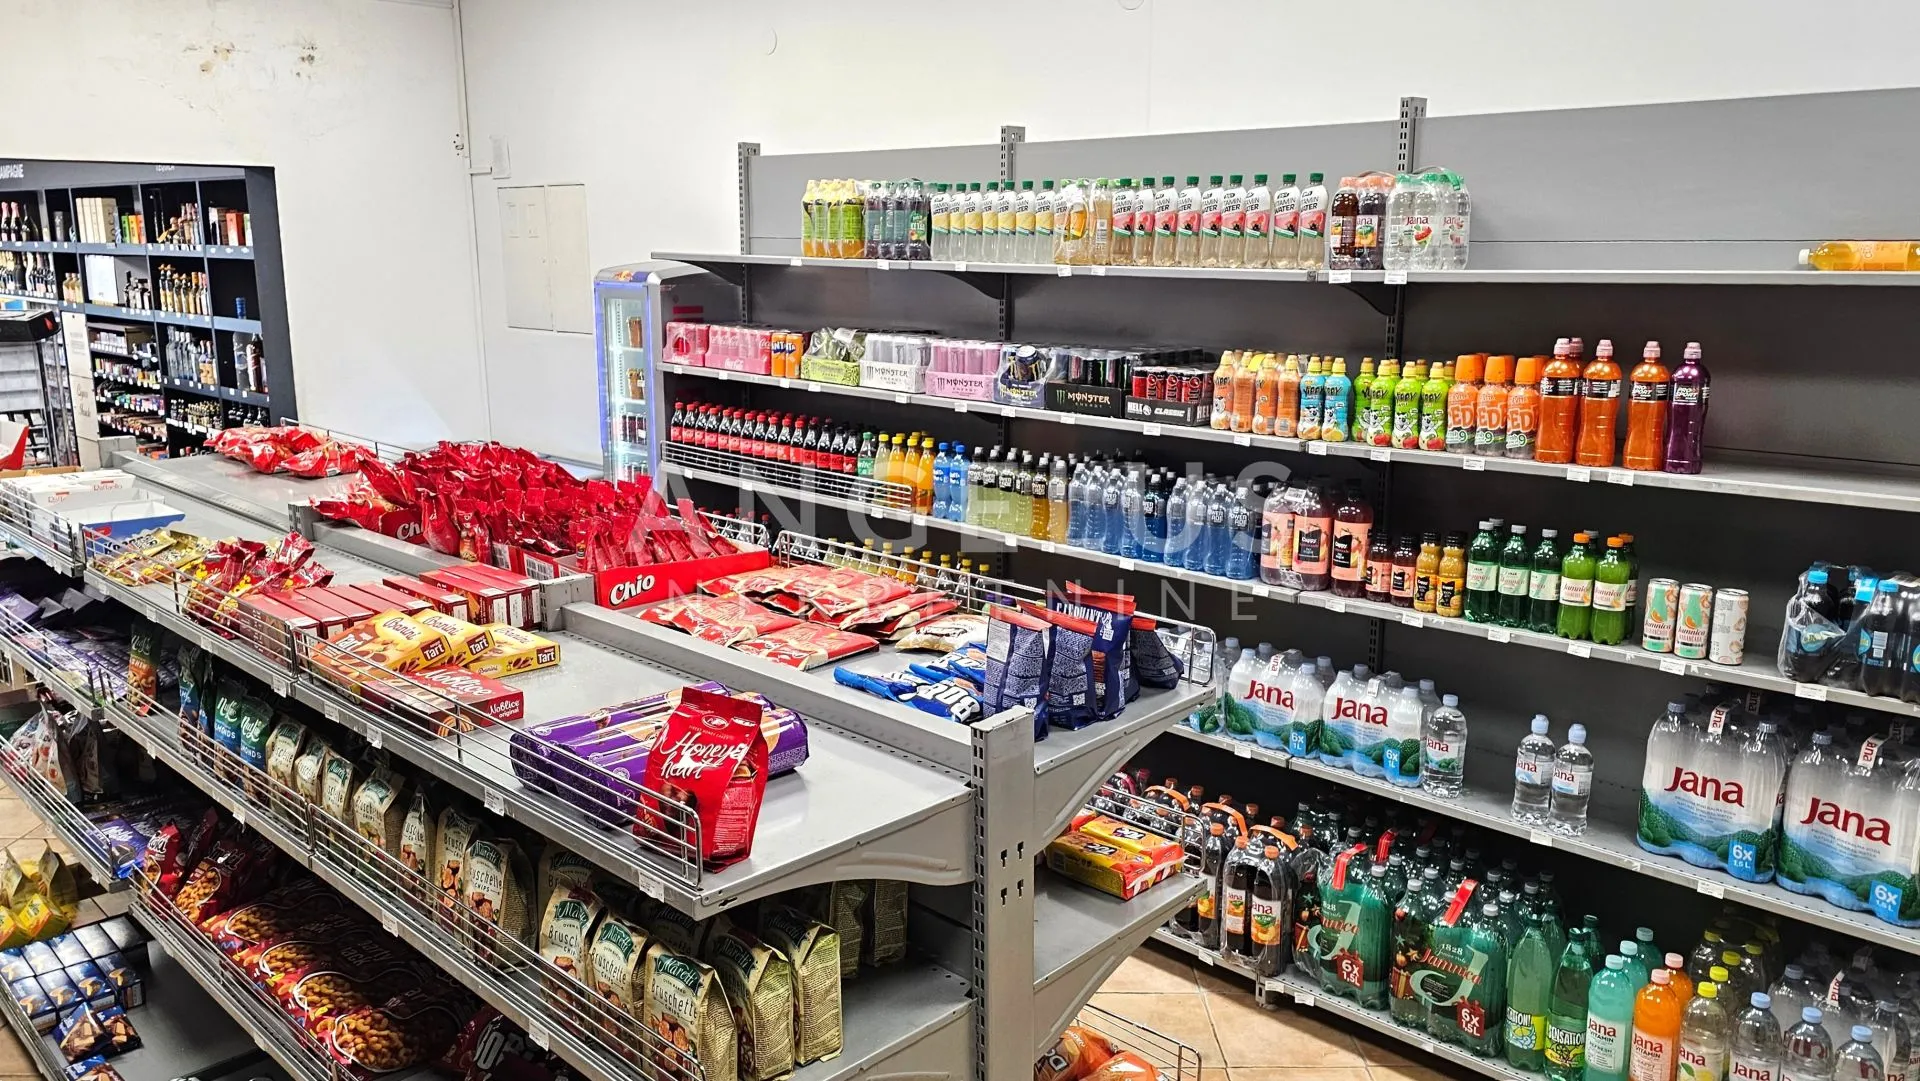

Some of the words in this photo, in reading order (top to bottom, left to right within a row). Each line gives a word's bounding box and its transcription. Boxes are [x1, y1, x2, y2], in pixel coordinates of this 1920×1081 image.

[874, 367, 908, 377] MONSTER
[946, 379, 984, 389] MONSTER
[1067, 391, 1111, 405] MONSTER
[1154, 407, 1186, 417] CLASSIC
[1196, 405, 1210, 420] HEL
[609, 574, 656, 606] Chio
[424, 643, 445, 660] Tart
[469, 637, 489, 655] Tart
[537, 650, 556, 664] Tart
[1244, 679, 1295, 711] Jana
[1332, 696, 1389, 728] Jana
[1291, 731, 1305, 744] 6x
[1386, 749, 1398, 762] 6x
[1663, 766, 1745, 809] Jana
[1799, 796, 1892, 847] Jana
[1732, 844, 1752, 861] 6x
[1874, 885, 1898, 906] 6x
[1252, 901, 1273, 915] ana
[1441, 943, 1464, 956] 1828
[657, 956, 699, 987] Maretti
[1341, 958, 1360, 977] 6X
[1419, 947, 1483, 985] Jamnica
[650, 977, 699, 1019] Bruschette
[1461, 1007, 1480, 1027] 6X
[1588, 1018, 1617, 1038] Jana
[1590, 1031, 1615, 1044] VITAMIN
[1633, 1033, 1664, 1054] Jana
[1635, 1046, 1661, 1059] VITAMIN
[1680, 1046, 1706, 1067] ana
[1733, 1061, 1771, 1081] Jana
